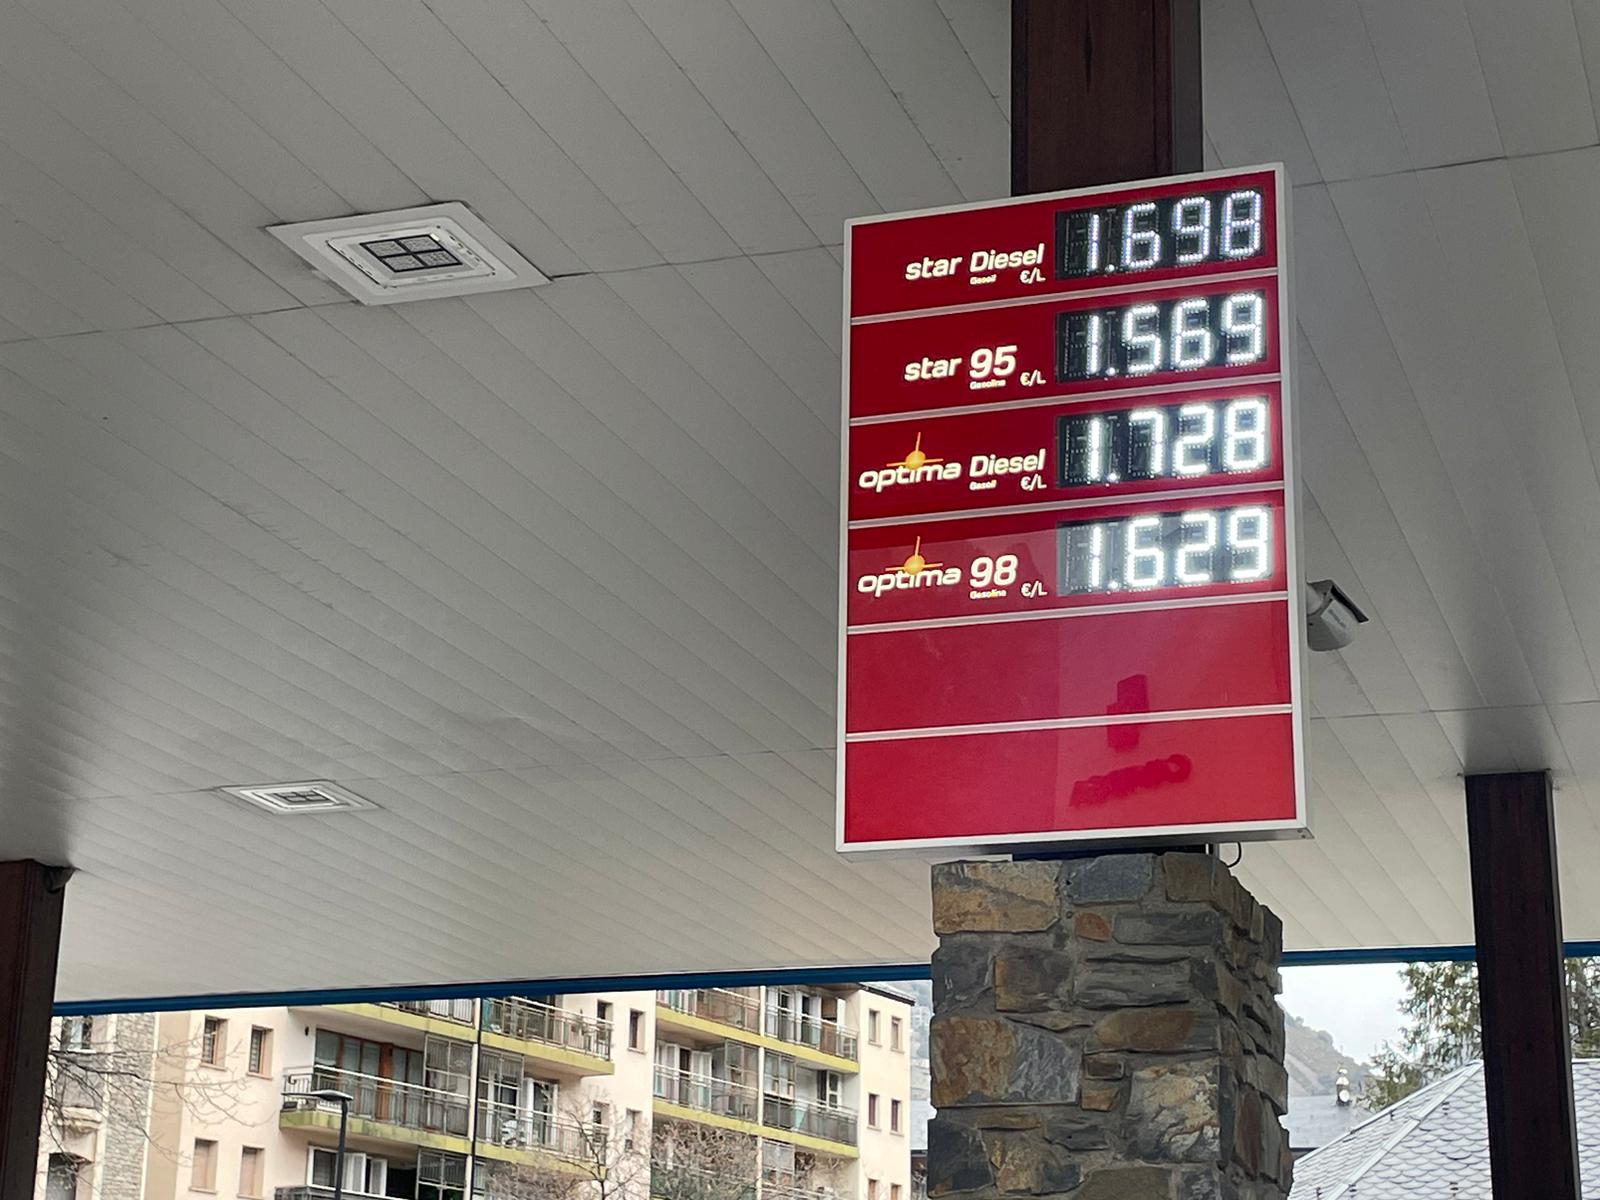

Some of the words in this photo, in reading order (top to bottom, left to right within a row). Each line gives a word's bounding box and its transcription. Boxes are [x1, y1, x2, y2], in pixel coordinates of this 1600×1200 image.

[1088, 190, 1262, 272] 1.698
[905, 256, 963, 281] star
[969, 243, 1045, 273] Diesel
[1019, 266, 1046, 284] €/L
[1087, 293, 1264, 375] 1.569
[904, 357, 962, 382] star
[969, 344, 1018, 378] 95
[1019, 369, 1047, 386] €/L
[1087, 400, 1268, 482] 1.728
[858, 458, 962, 493] optima
[969, 449, 1046, 478] Diesel
[1020, 473, 1048, 491] €/L
[1088, 506, 1272, 592] 1.629
[857, 563, 962, 598] optima
[969, 554, 1019, 588] 98
[1020, 580, 1048, 598] €/L
